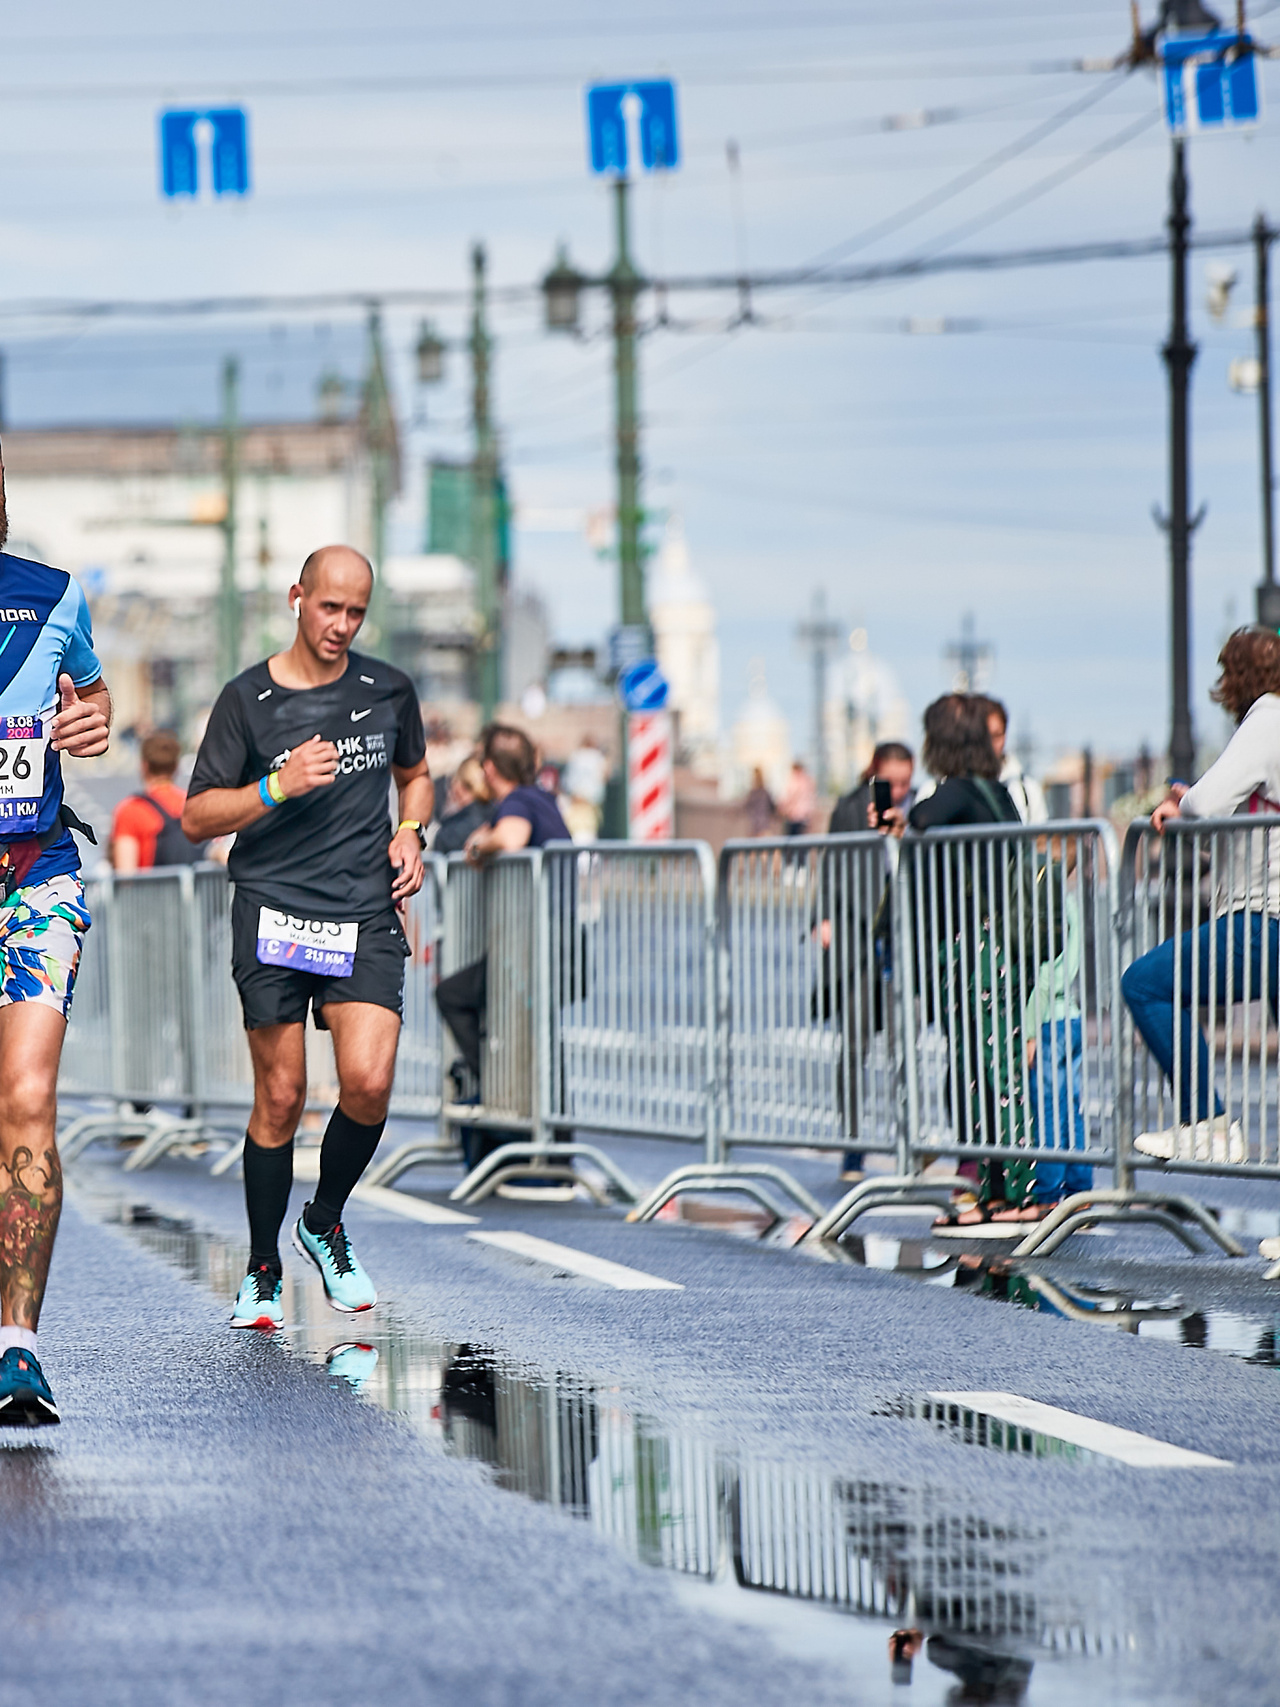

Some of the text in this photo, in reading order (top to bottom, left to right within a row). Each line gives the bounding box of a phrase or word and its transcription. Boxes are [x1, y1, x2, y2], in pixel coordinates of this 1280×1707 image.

[7, 716, 34, 728] 8.08
[7, 728, 34, 739] 2021
[16, 802, 37, 816] КМ
[267, 940, 280, 955] C
